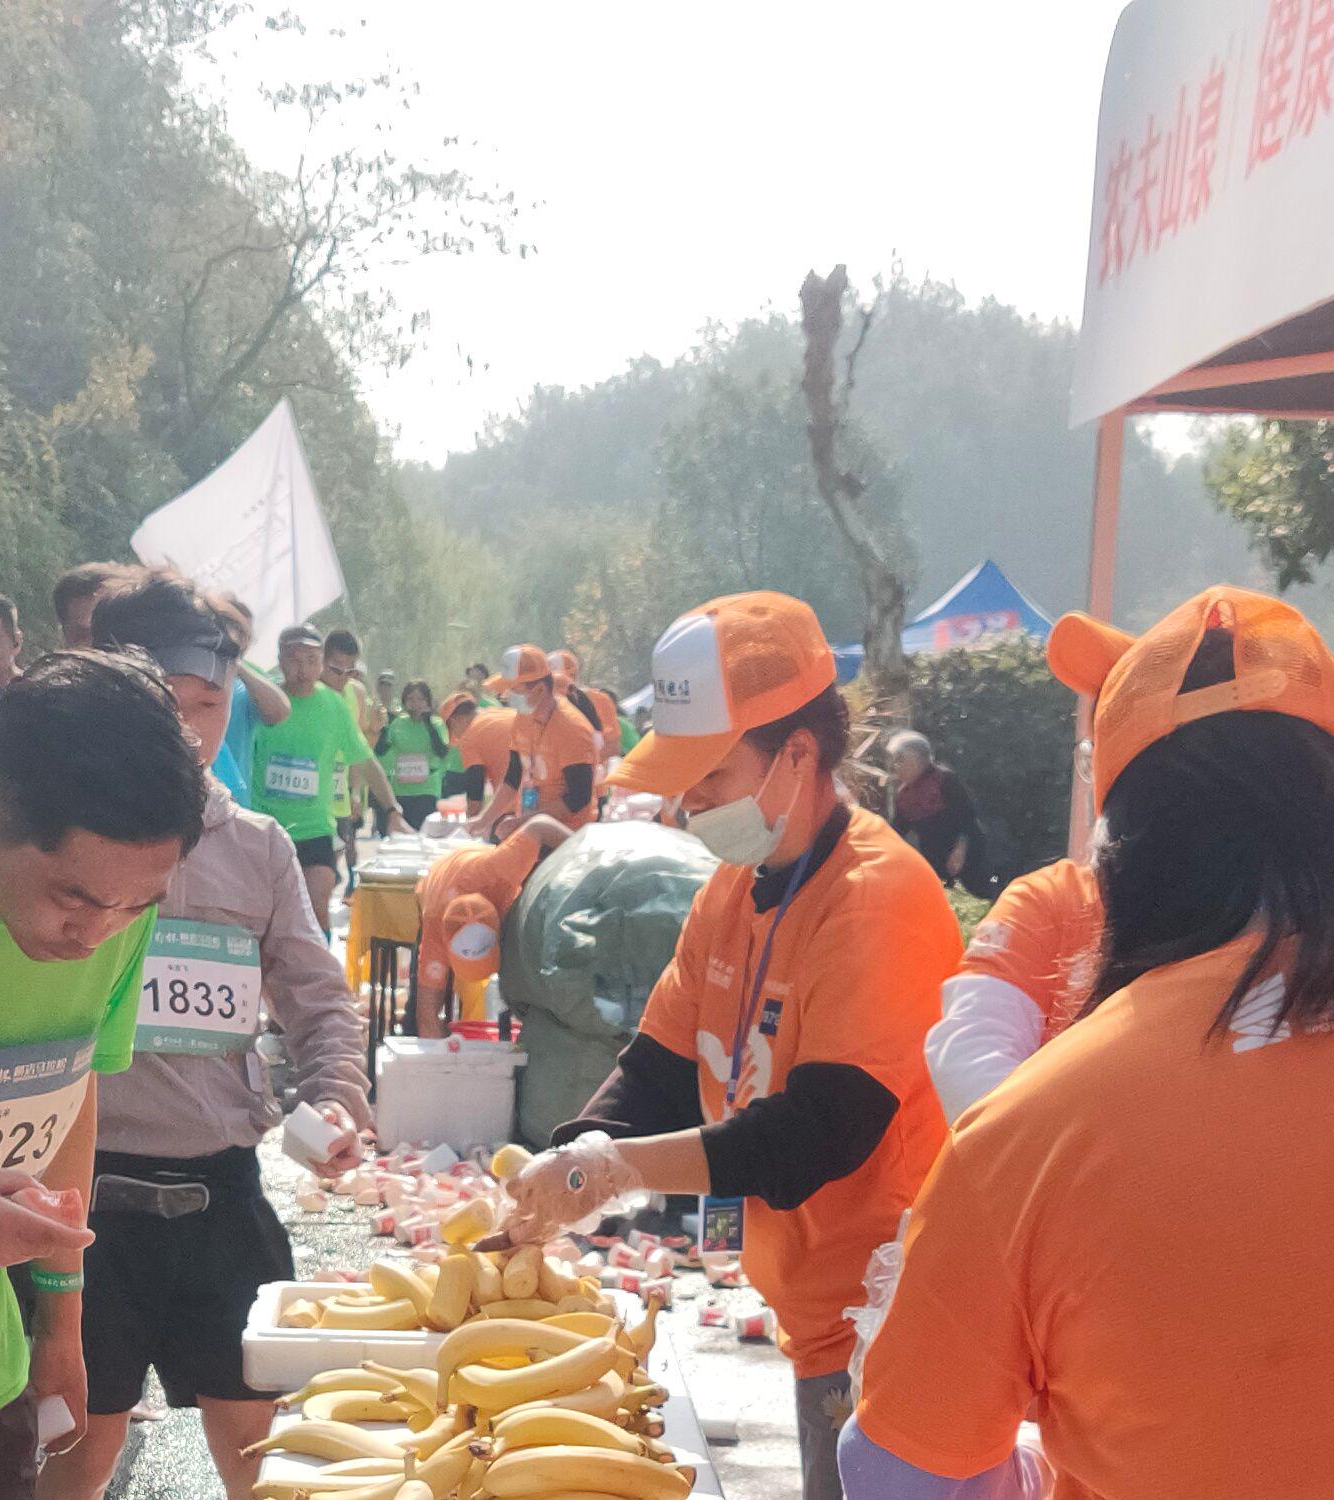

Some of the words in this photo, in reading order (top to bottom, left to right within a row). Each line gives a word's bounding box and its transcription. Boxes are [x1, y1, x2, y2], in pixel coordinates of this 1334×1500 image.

[1099, 56, 1225, 290] 农夫山泉
[143, 977, 236, 1019] 1833
